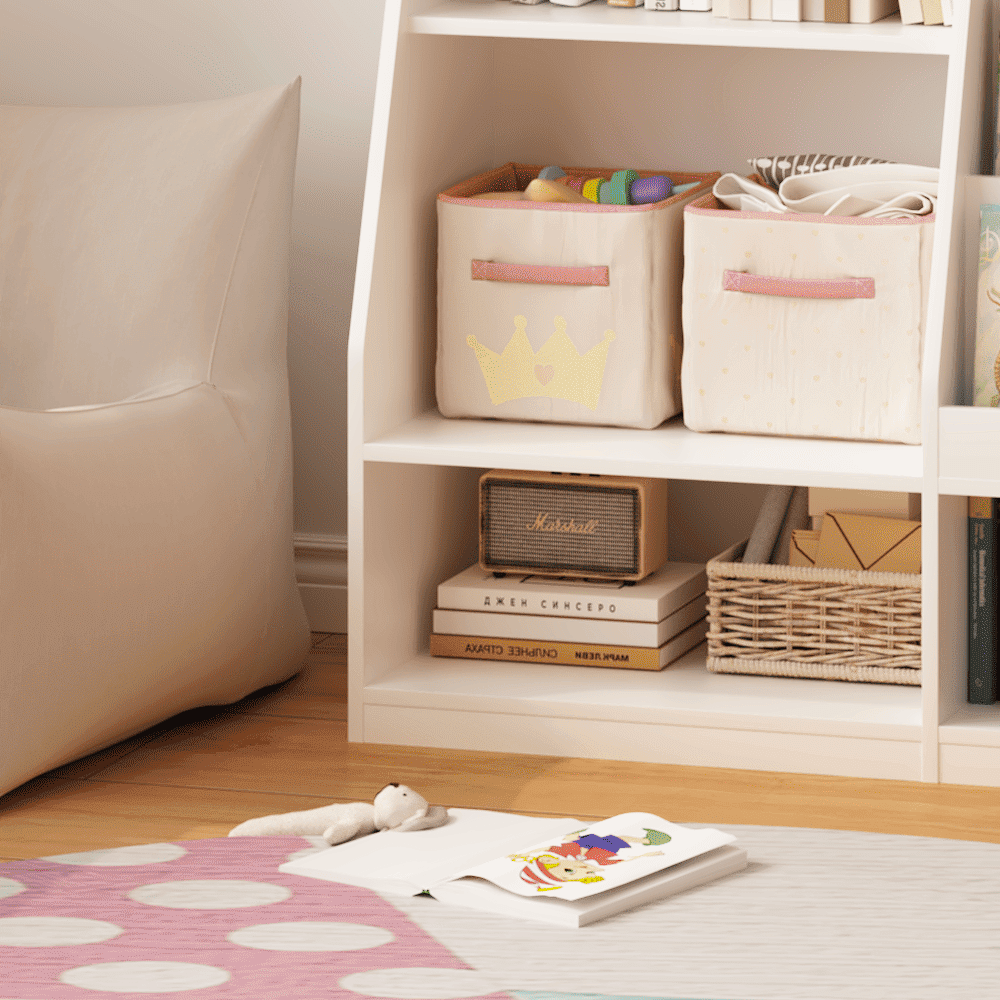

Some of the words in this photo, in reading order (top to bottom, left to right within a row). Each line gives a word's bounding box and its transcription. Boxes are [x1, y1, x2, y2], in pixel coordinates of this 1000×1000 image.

[526, 512, 600, 535] Marshall
[484, 596, 528, 608] ДЖЕН
[540, 599, 617, 613] СИНСЕРО
